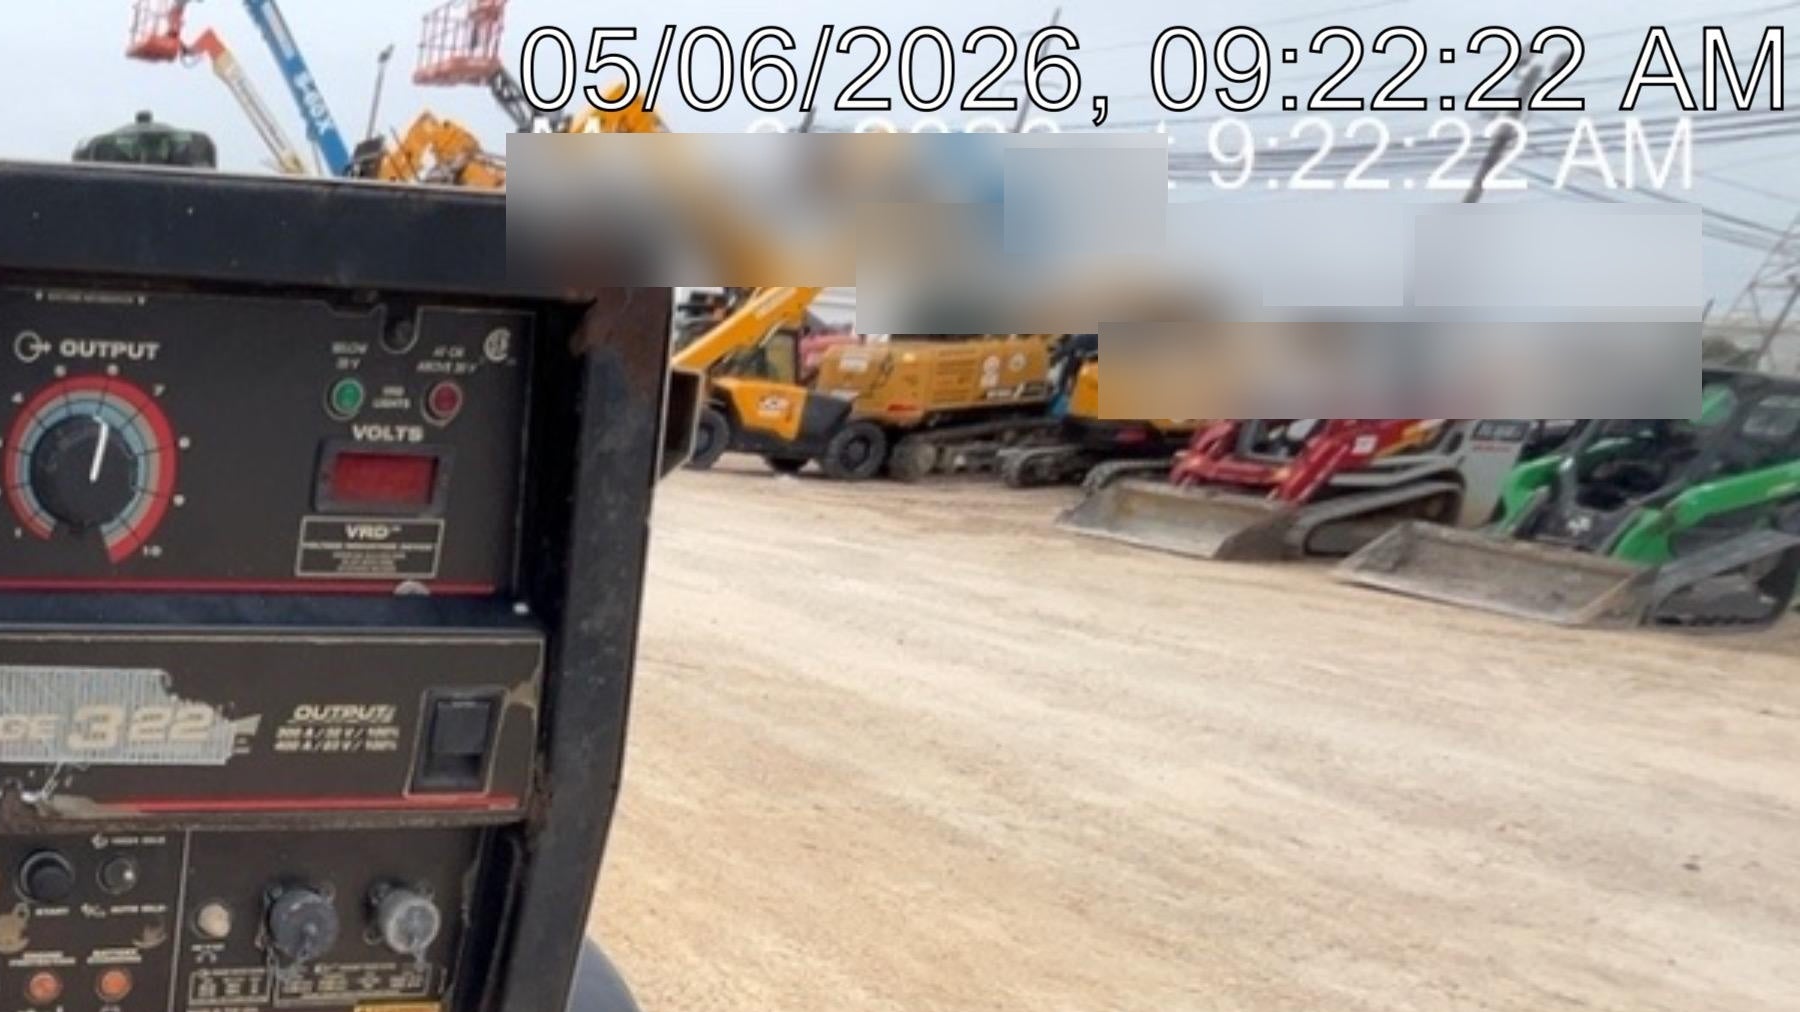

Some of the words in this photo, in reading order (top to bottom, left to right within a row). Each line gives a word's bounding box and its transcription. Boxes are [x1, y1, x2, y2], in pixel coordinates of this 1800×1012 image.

[58, 338, 161, 361] OUTPUT
[352, 424, 425, 443] VOLTS
[67, 701, 216, 751] 322
